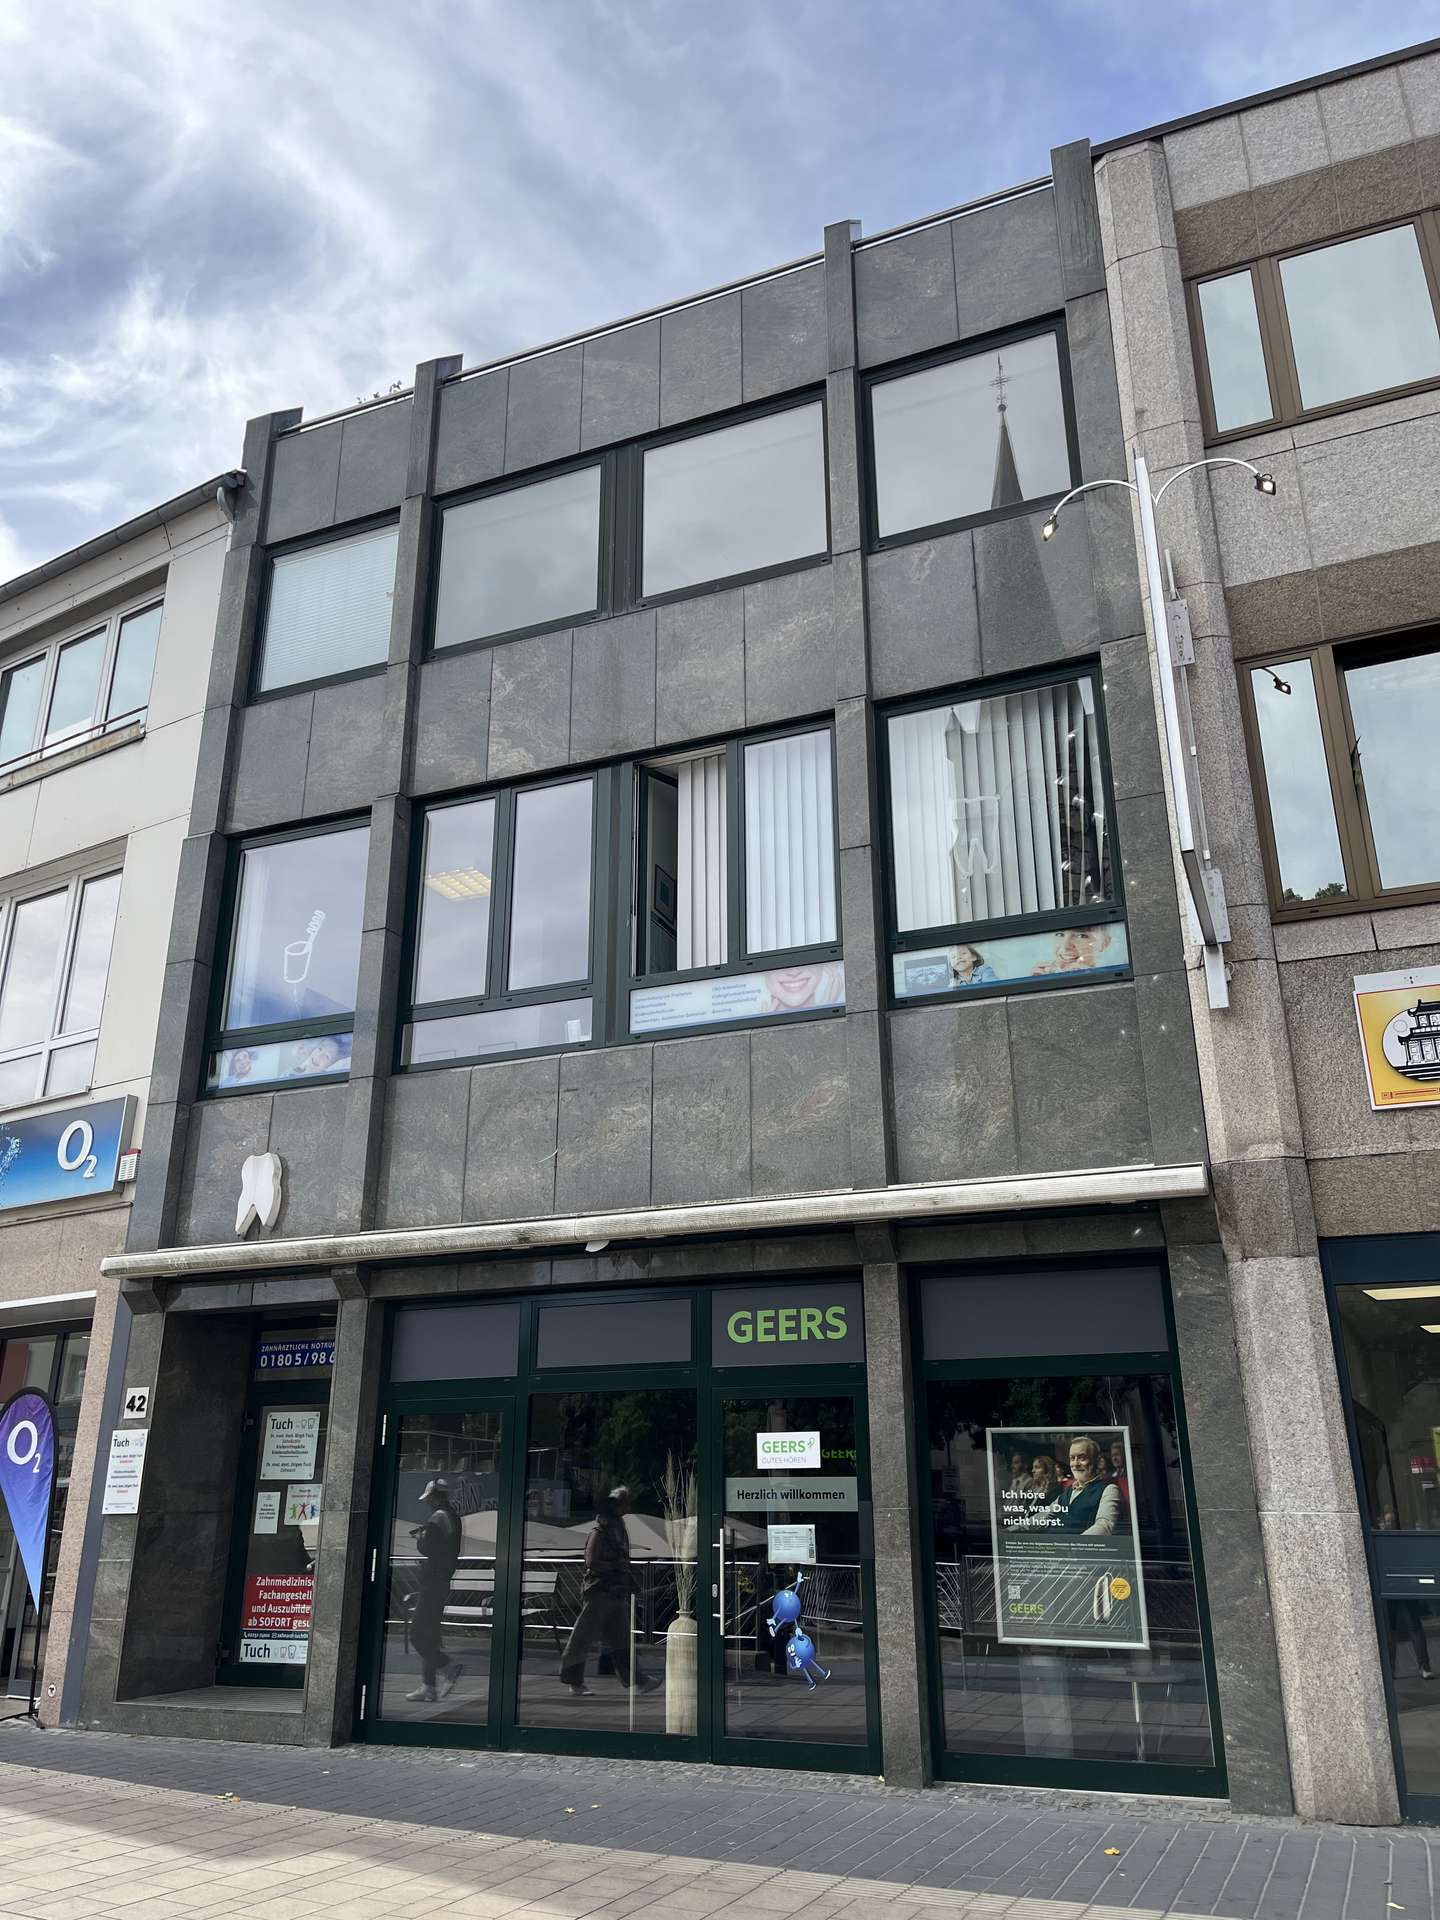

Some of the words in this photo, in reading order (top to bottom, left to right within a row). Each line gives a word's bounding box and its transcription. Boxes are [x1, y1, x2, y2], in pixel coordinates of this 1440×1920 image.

[727, 1306, 848, 1344] GEERS
[126, 1395, 146, 1412] 42
[271, 1418, 294, 1430] Tuch
[113, 1438, 130, 1447] Tuch
[761, 1440, 806, 1453] GEERS
[737, 1489, 777, 1500] Herzlich
[780, 1489, 845, 1500] willkommen
[1002, 1490, 1017, 1499] Ich
[1020, 1490, 1046, 1500] höre
[1003, 1505, 1027, 1514] was,
[1029, 1504, 1050, 1513] was
[1052, 1503, 1069, 1514] Du
[1003, 1516, 1031, 1526] nicht
[1032, 1517, 1065, 1527] hörst.
[251, 1605, 266, 1613] und
[1009, 1603, 1045, 1615] GEERS
[247, 1617, 257, 1626] ab
[259, 1617, 292, 1627] SOFORT
[244, 1643, 271, 1658] Tuch
